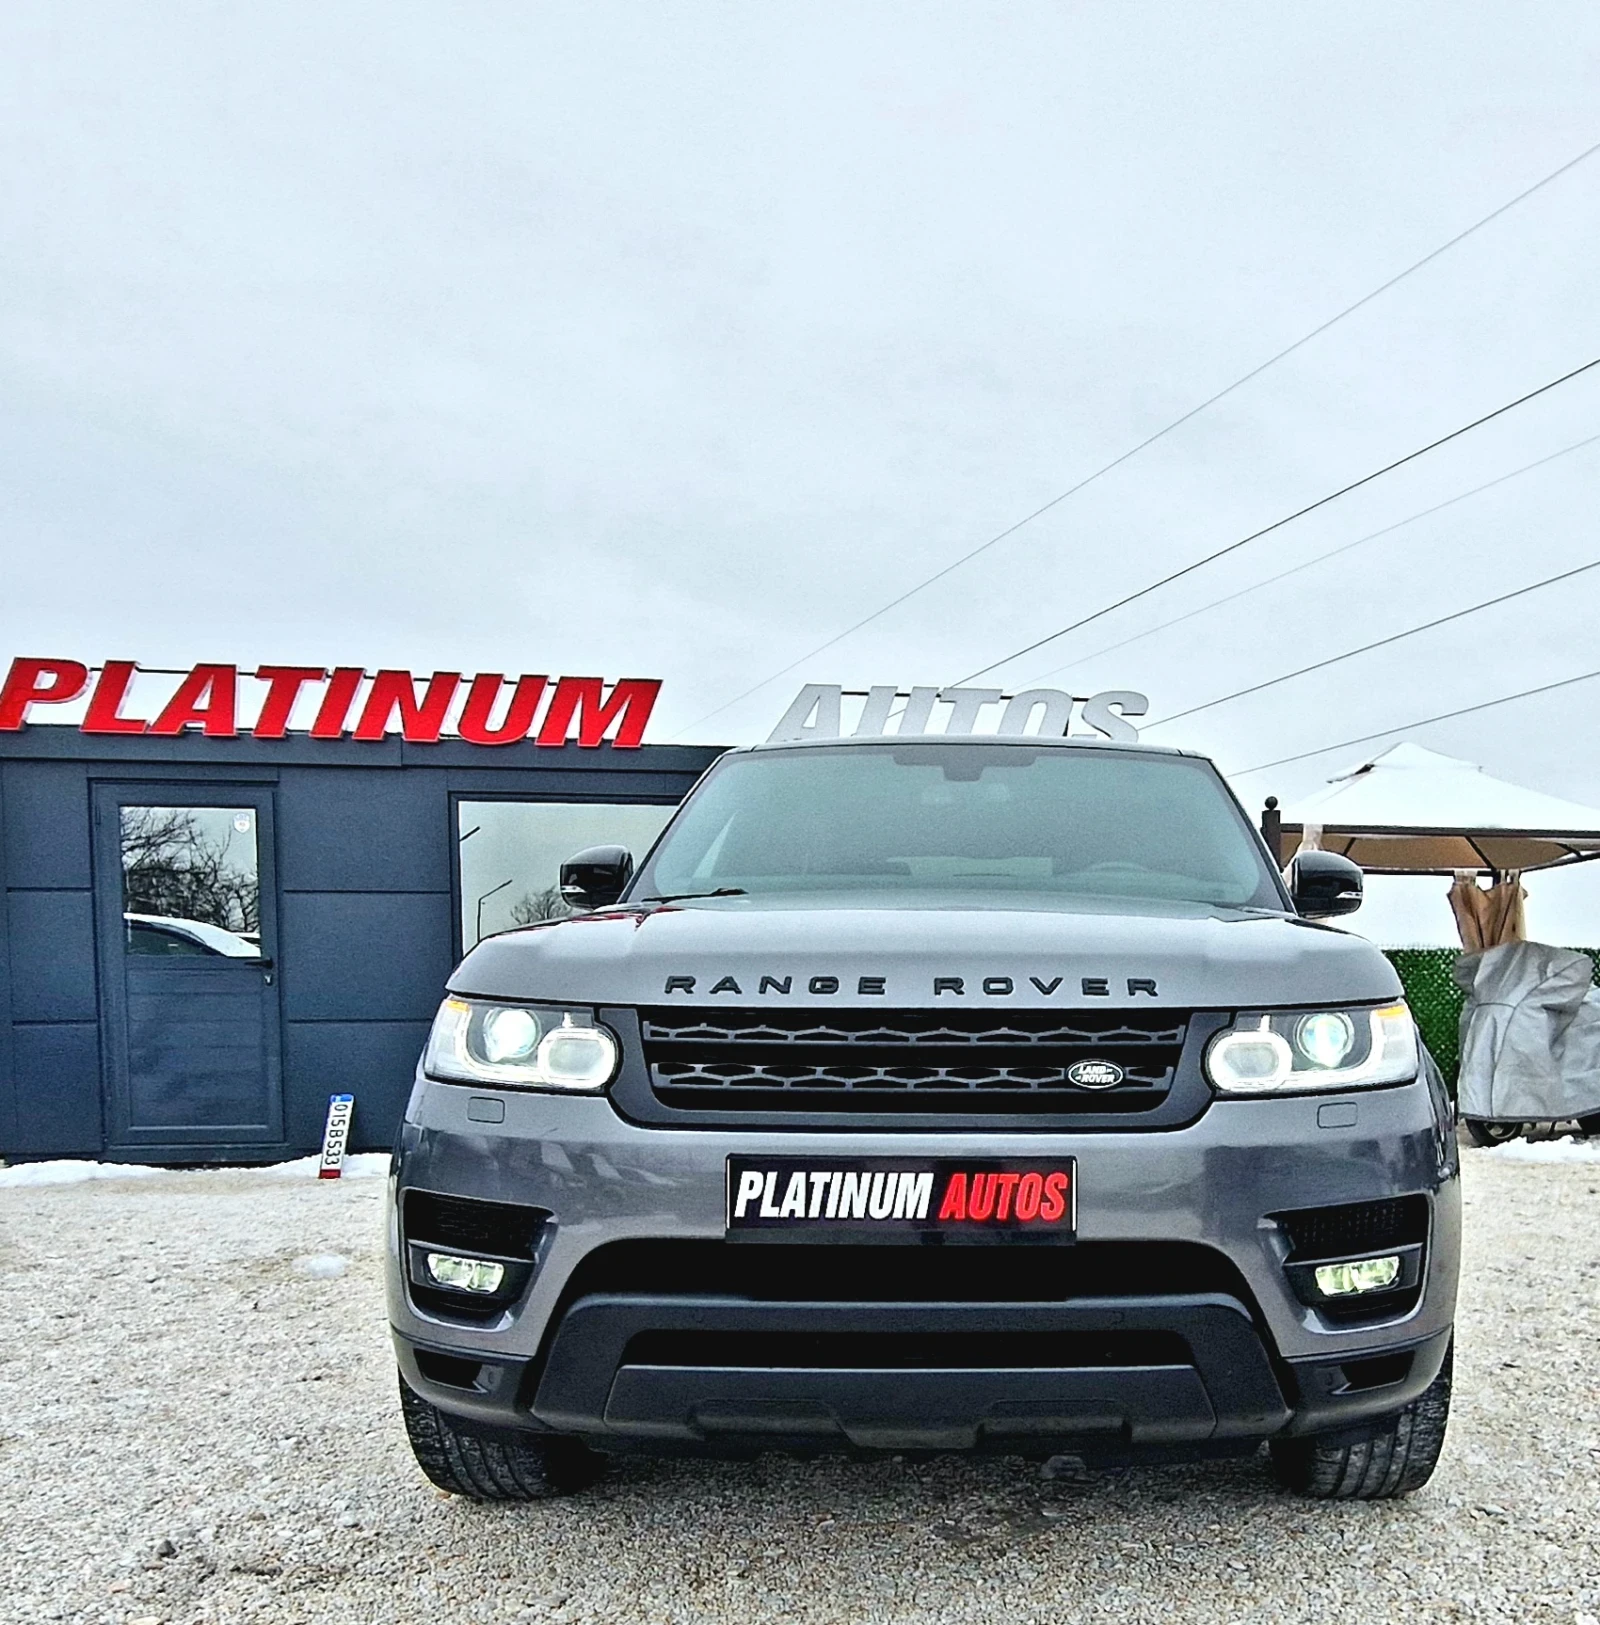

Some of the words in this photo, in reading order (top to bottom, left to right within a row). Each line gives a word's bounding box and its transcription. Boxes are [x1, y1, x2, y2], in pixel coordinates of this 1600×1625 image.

[0, 656, 664, 749] PLATINUM
[767, 683, 1149, 742] AUTOS
[664, 975, 886, 995] RANGE
[934, 976, 1158, 996] ROVER
[734, 1171, 934, 1220] PLATINUM
[939, 1172, 1068, 1221] AUTOS
